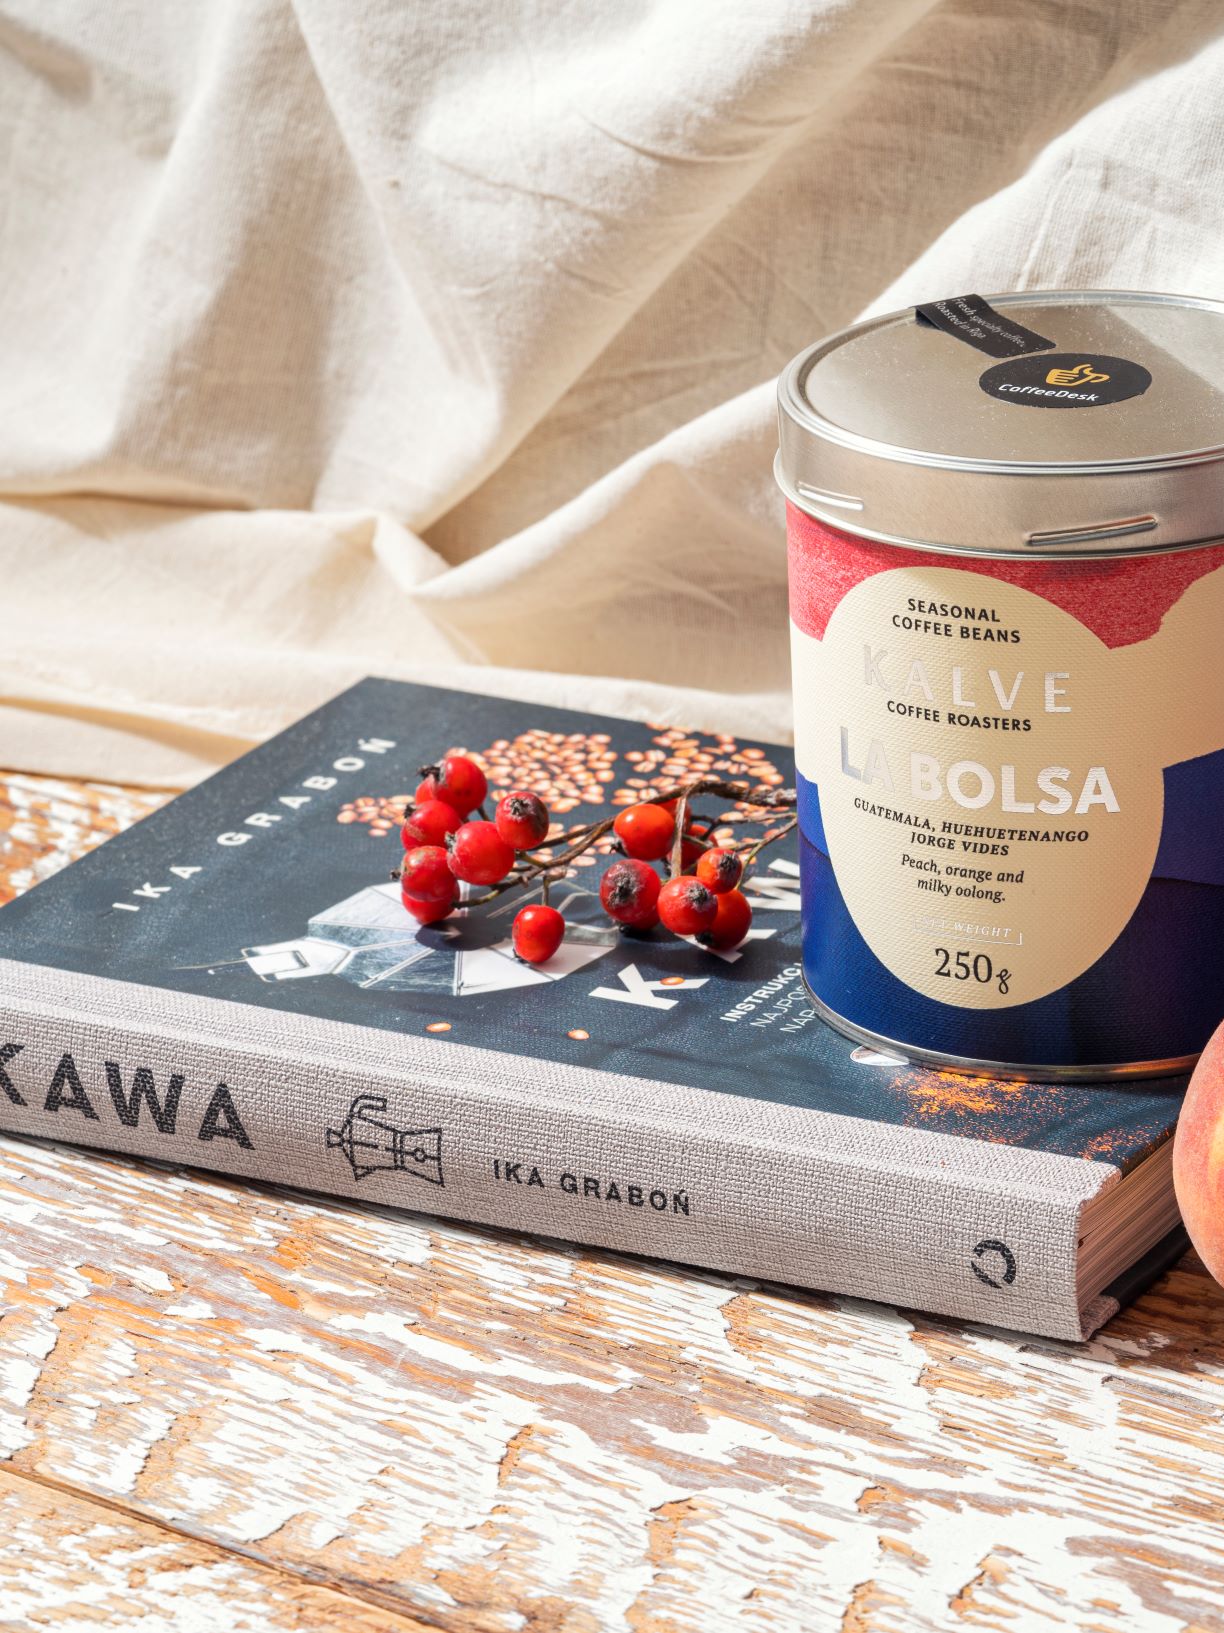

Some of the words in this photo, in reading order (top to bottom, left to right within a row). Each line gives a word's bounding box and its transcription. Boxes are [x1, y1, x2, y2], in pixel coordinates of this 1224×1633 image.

[933, 301, 968, 326] Roasted
[998, 383, 1100, 402] CoffeeDesk
[907, 598, 1001, 623] SEASONAL
[892, 615, 953, 638] COFFEE
[959, 625, 1021, 644] BEANS
[863, 644, 1072, 714] KALVE
[887, 700, 940, 723] COFFEE
[947, 712, 1032, 732] ROASTERS
[840, 726, 895, 793] LA
[910, 751, 1121, 816] BOLSA
[112, 866, 202, 911] IKA
[216, 737, 397, 846] GRABOŃ
[854, 797, 936, 832] GUATEMALA,
[941, 821, 1089, 842] HUEHUETENANGO
[910, 831, 956, 850] JORGE
[961, 840, 1010, 856] VIDES
[901, 853, 941, 875] Peach,
[945, 865, 992, 882] orange
[996, 870, 1025, 883] and
[917, 878, 951, 896] milky
[955, 886, 1006, 904] oolong.
[954, 921, 1012, 938] WEIGHT
[0, 1042, 256, 1150] KAWA
[493, 1159, 545, 1188] IKA
[559, 1172, 690, 1216] GRABOŃ
